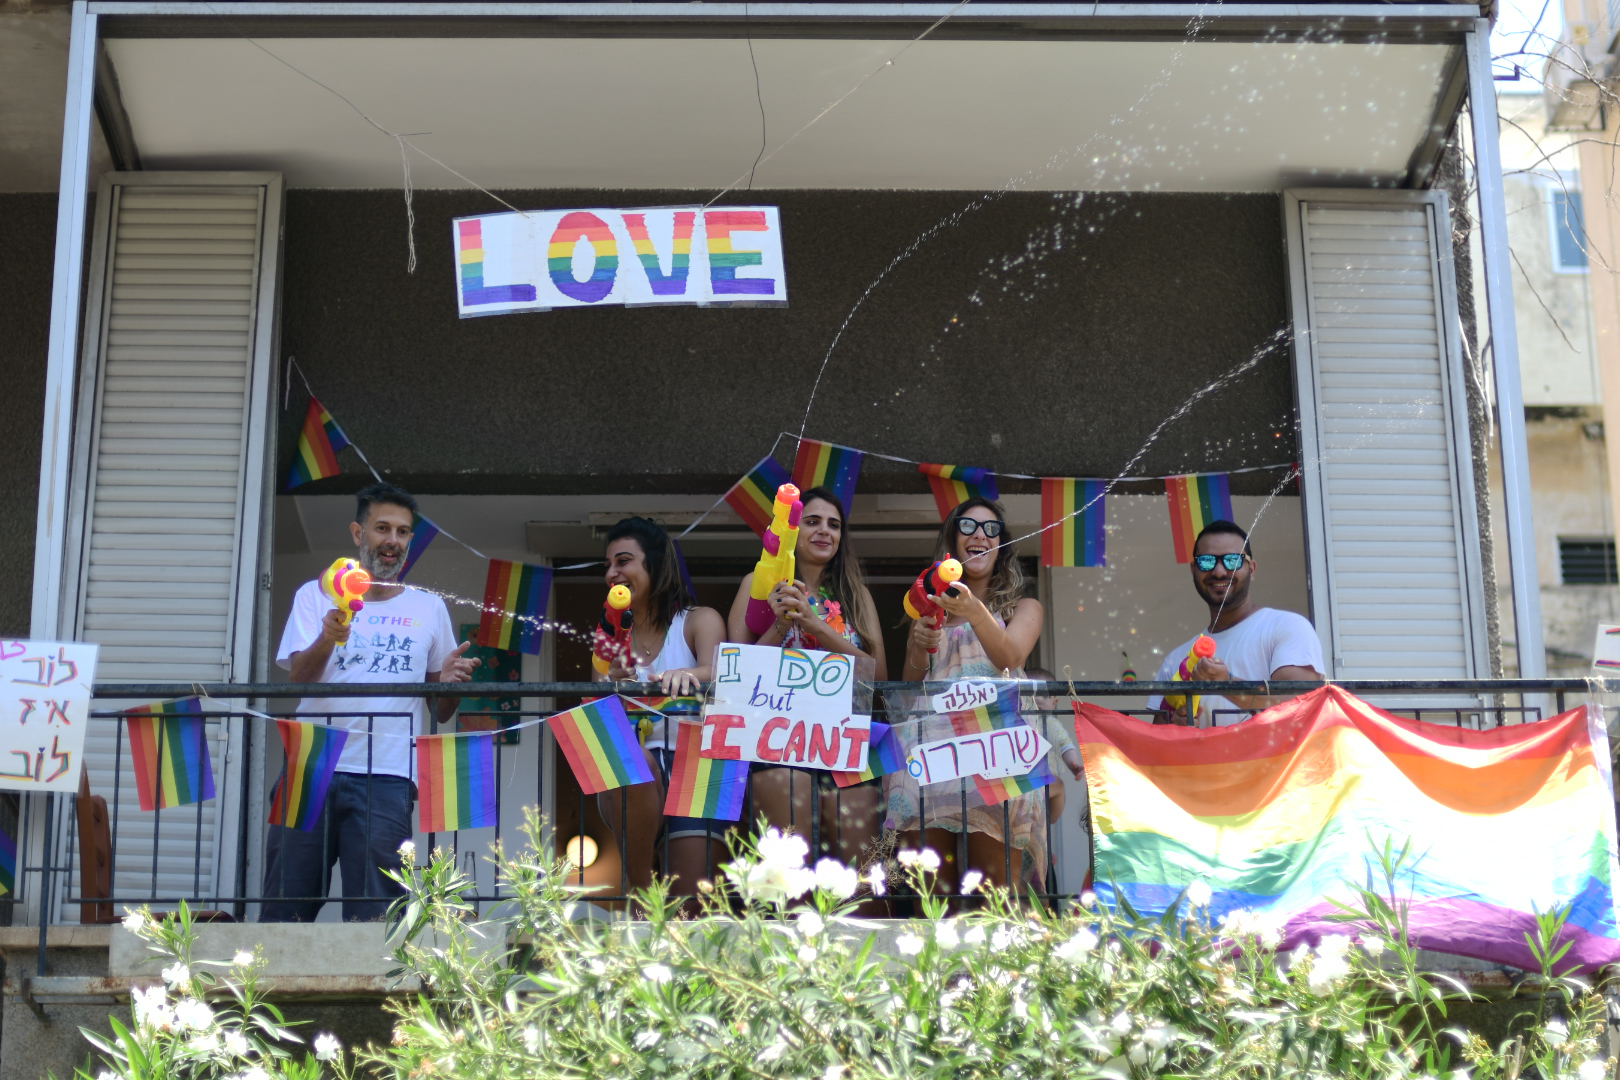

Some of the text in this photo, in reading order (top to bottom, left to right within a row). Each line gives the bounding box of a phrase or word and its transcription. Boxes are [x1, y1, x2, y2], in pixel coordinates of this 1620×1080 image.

[458, 210, 776, 306] LOVE
[367, 615, 423, 628] OTHER
[718, 647, 851, 697] I DO
[748, 674, 796, 712] but
[941, 684, 995, 710] יאללה
[700, 714, 746, 760] I
